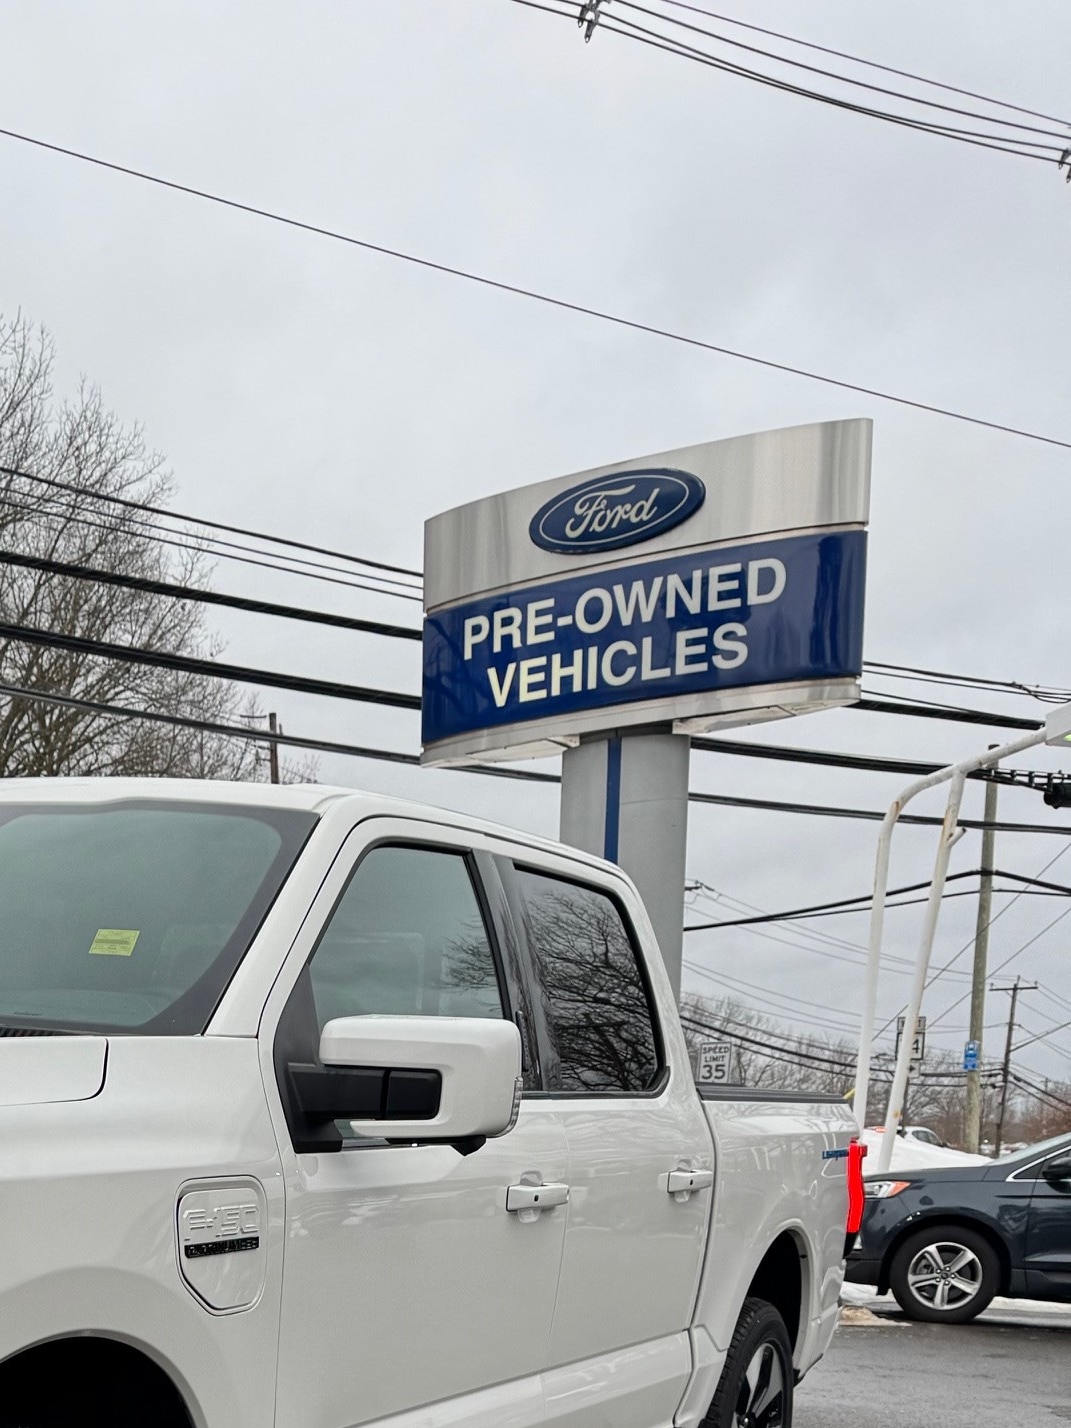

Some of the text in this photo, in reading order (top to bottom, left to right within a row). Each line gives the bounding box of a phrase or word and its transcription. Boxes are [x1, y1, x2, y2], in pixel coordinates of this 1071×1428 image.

[564, 483, 663, 538] Ford
[463, 557, 787, 661] PRE-OWNED
[486, 622, 749, 708] VEHICLES
[702, 1045, 729, 1055] SPEED
[704, 1055, 726, 1063] LIMIT
[701, 1064, 726, 1080] 35
